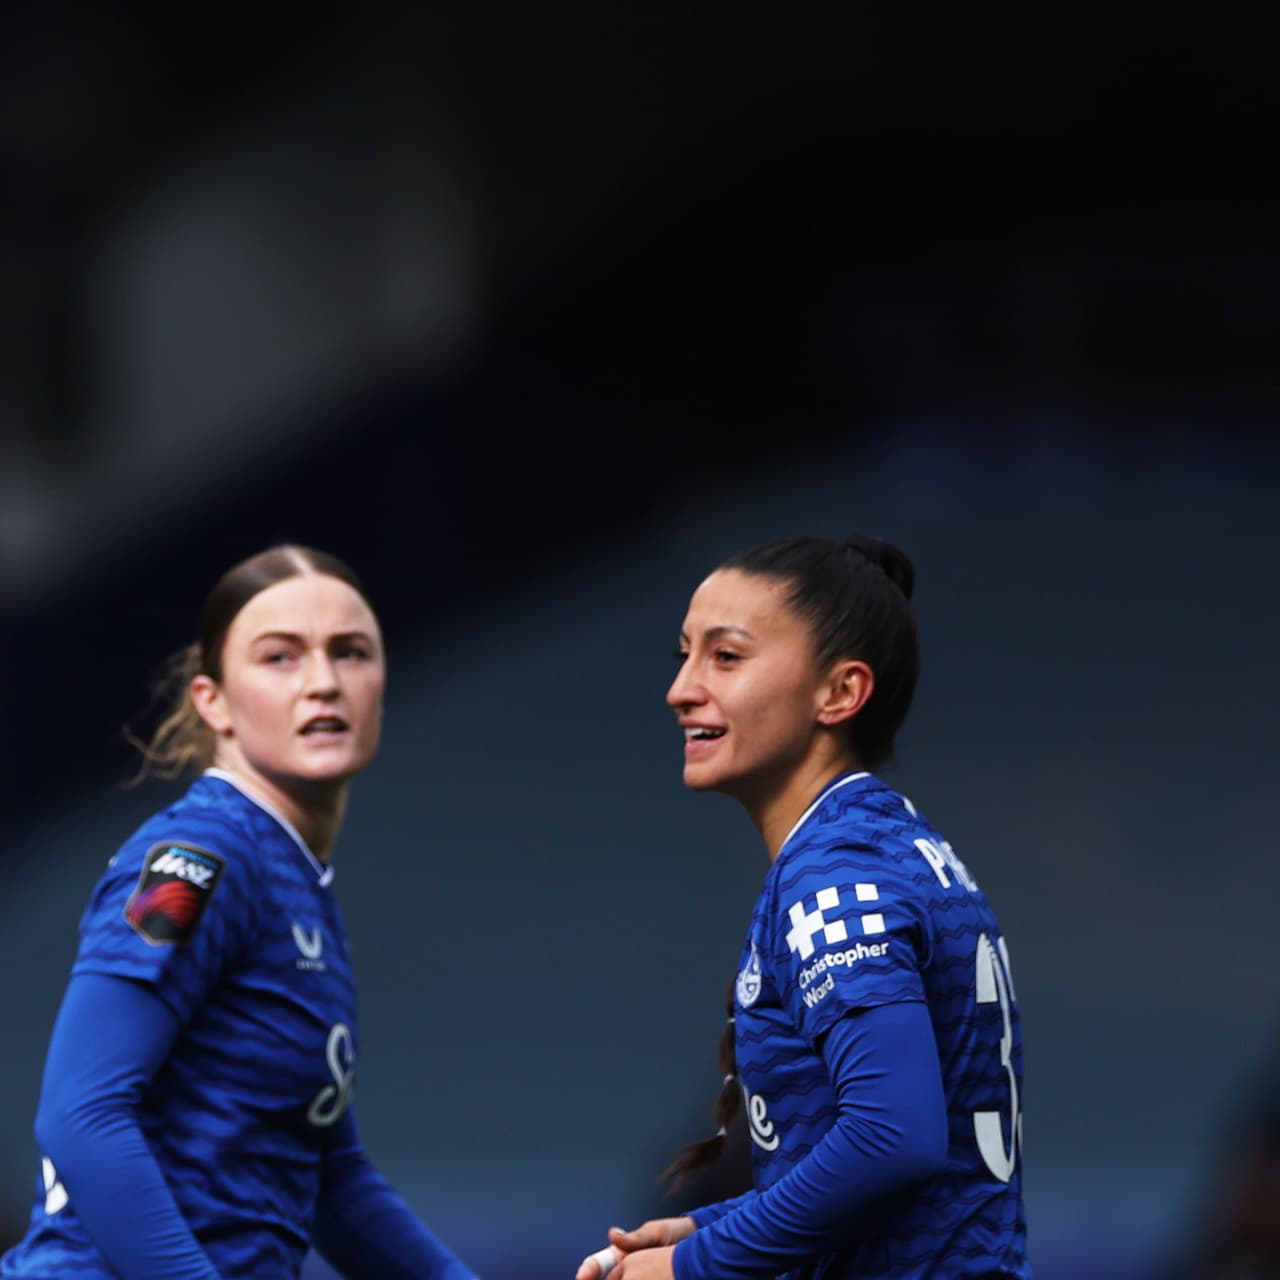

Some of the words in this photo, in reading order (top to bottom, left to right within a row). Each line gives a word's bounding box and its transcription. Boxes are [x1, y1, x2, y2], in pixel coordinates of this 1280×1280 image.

[798, 942, 890, 990] Christopher
[802, 972, 835, 1009] Ward
[973, 932, 1024, 1184] 3
